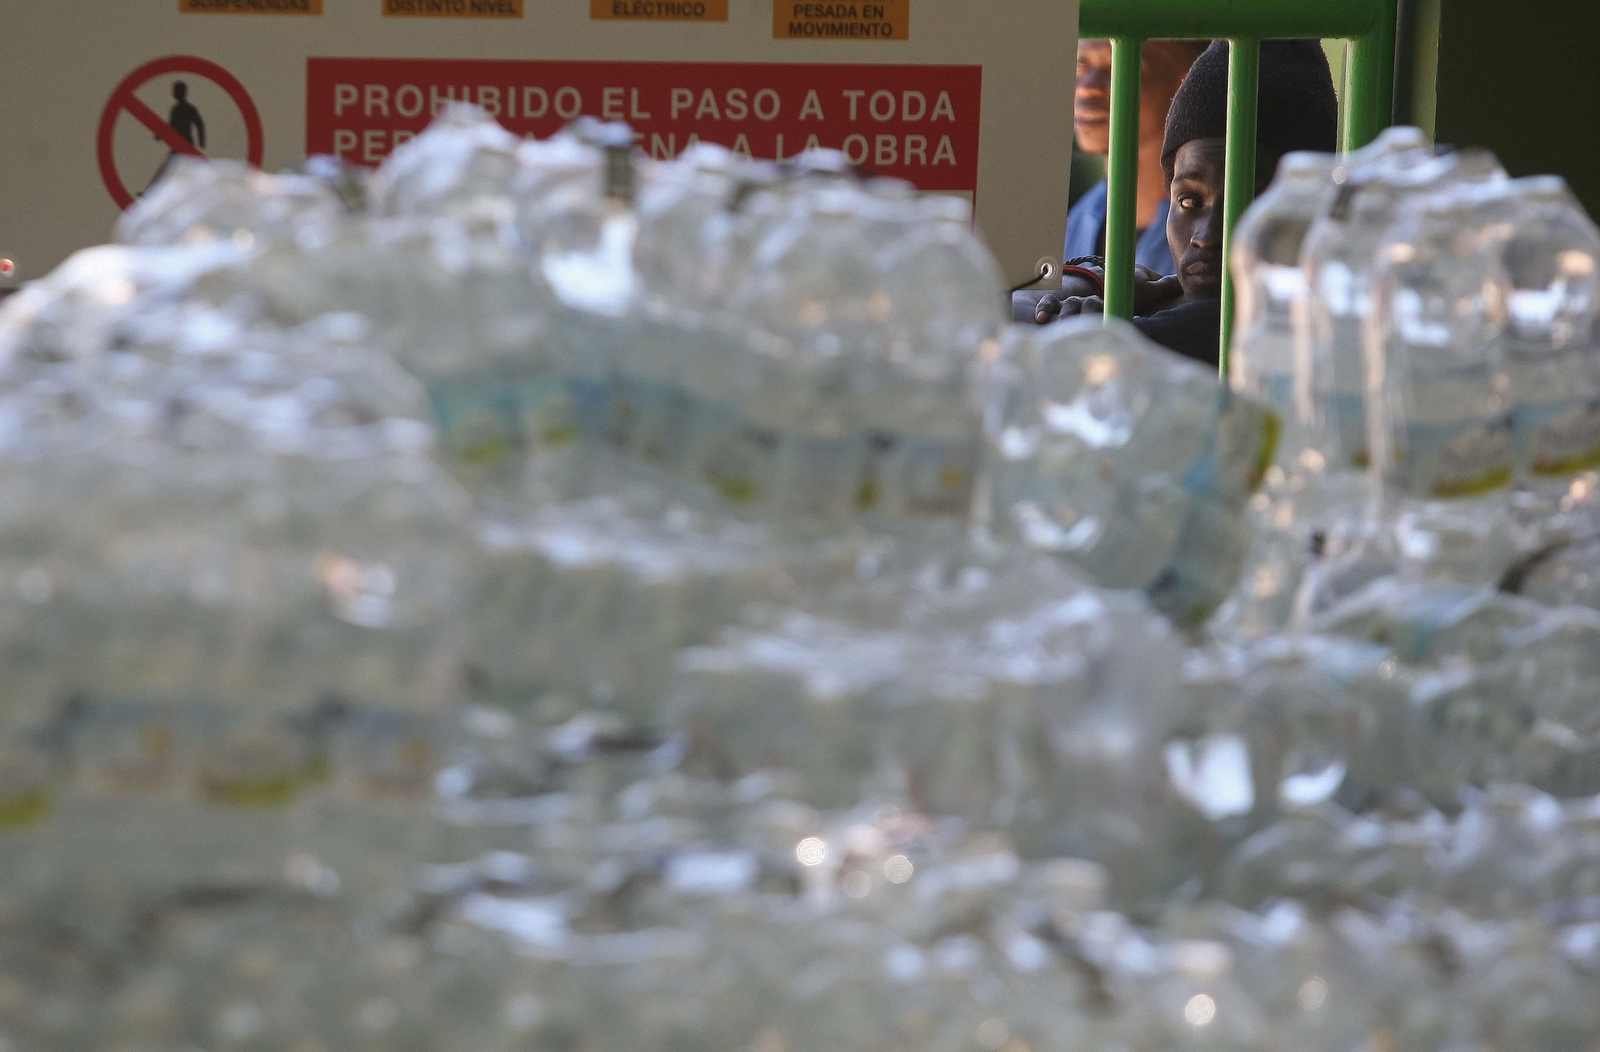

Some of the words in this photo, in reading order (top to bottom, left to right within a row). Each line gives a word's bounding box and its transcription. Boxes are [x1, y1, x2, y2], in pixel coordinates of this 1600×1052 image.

[388, 0, 466, 14] DISTINTO
[471, 0, 518, 15] NIVEL
[793, 3, 857, 19] PESADA
[863, 4, 885, 19] EN
[788, 21, 893, 37] MOVIMIENTO
[603, 87, 651, 119] EL
[670, 88, 782, 121] PASO
[799, 89, 825, 121] A
[843, 89, 956, 122] TODA
[842, 134, 957, 166] OBRA
